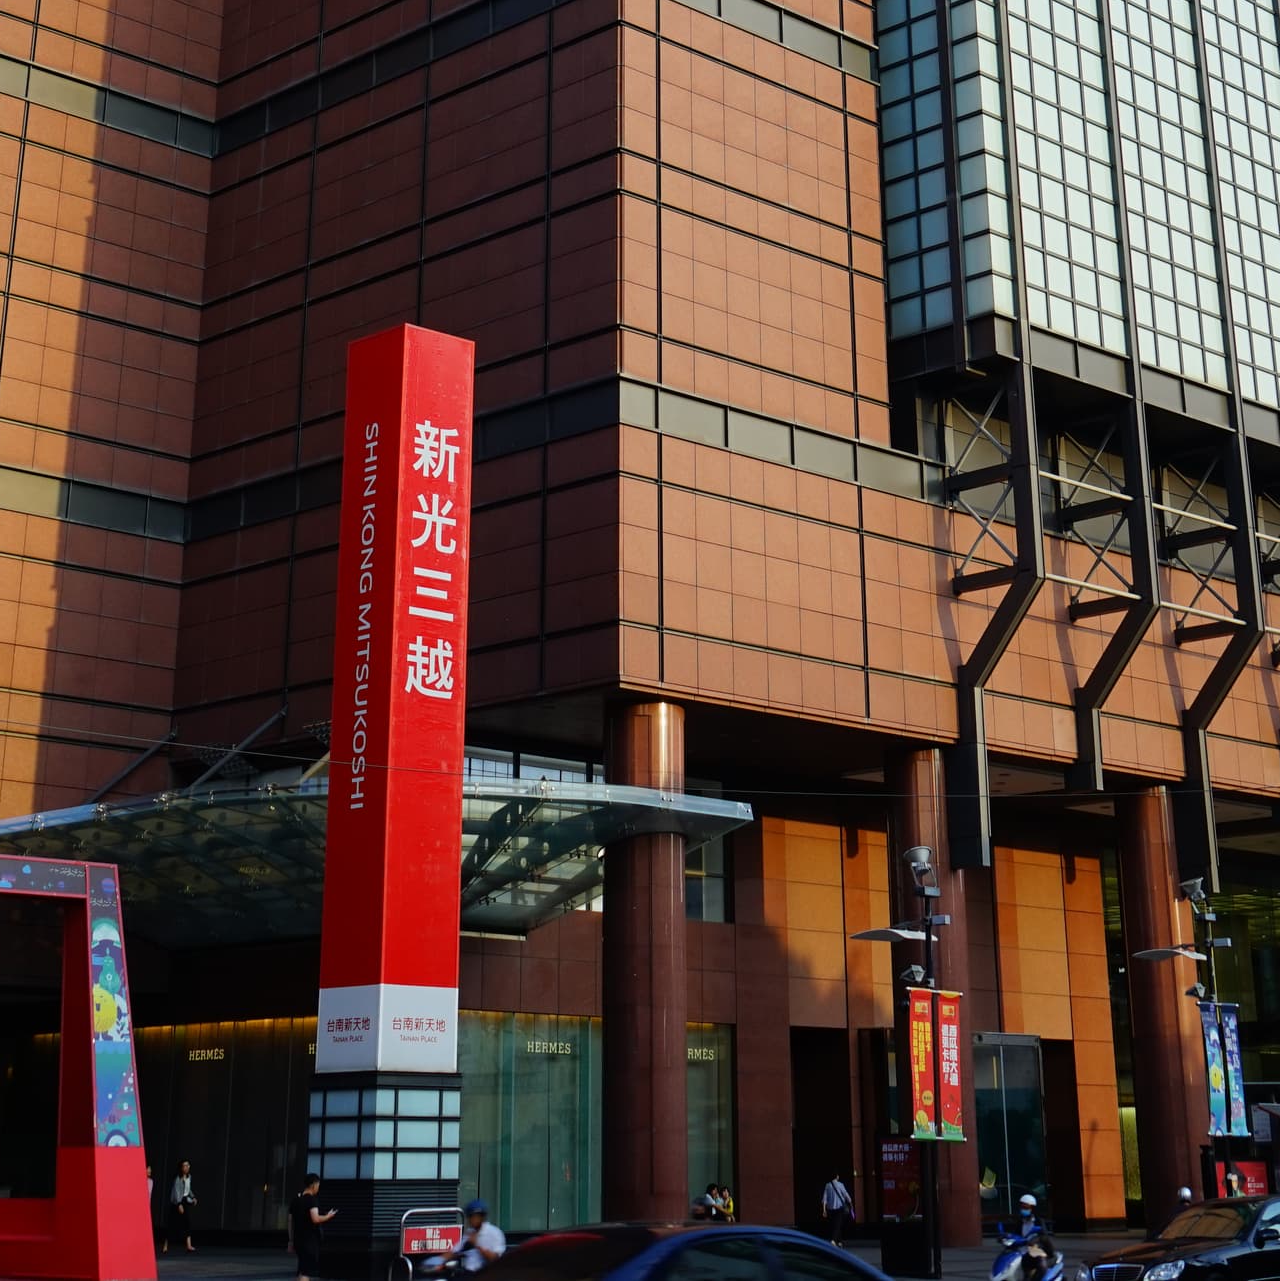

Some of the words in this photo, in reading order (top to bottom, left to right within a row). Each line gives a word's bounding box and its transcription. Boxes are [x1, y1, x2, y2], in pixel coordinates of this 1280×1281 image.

[364, 422, 380, 496] SHIN
[359, 503, 377, 592] KONG
[405, 420, 461, 700] 新光三越
[349, 603, 373, 810] MITSUKOSHI
[327, 1017, 370, 1032] 台南新天地
[392, 1017, 446, 1033] 台南新天地
